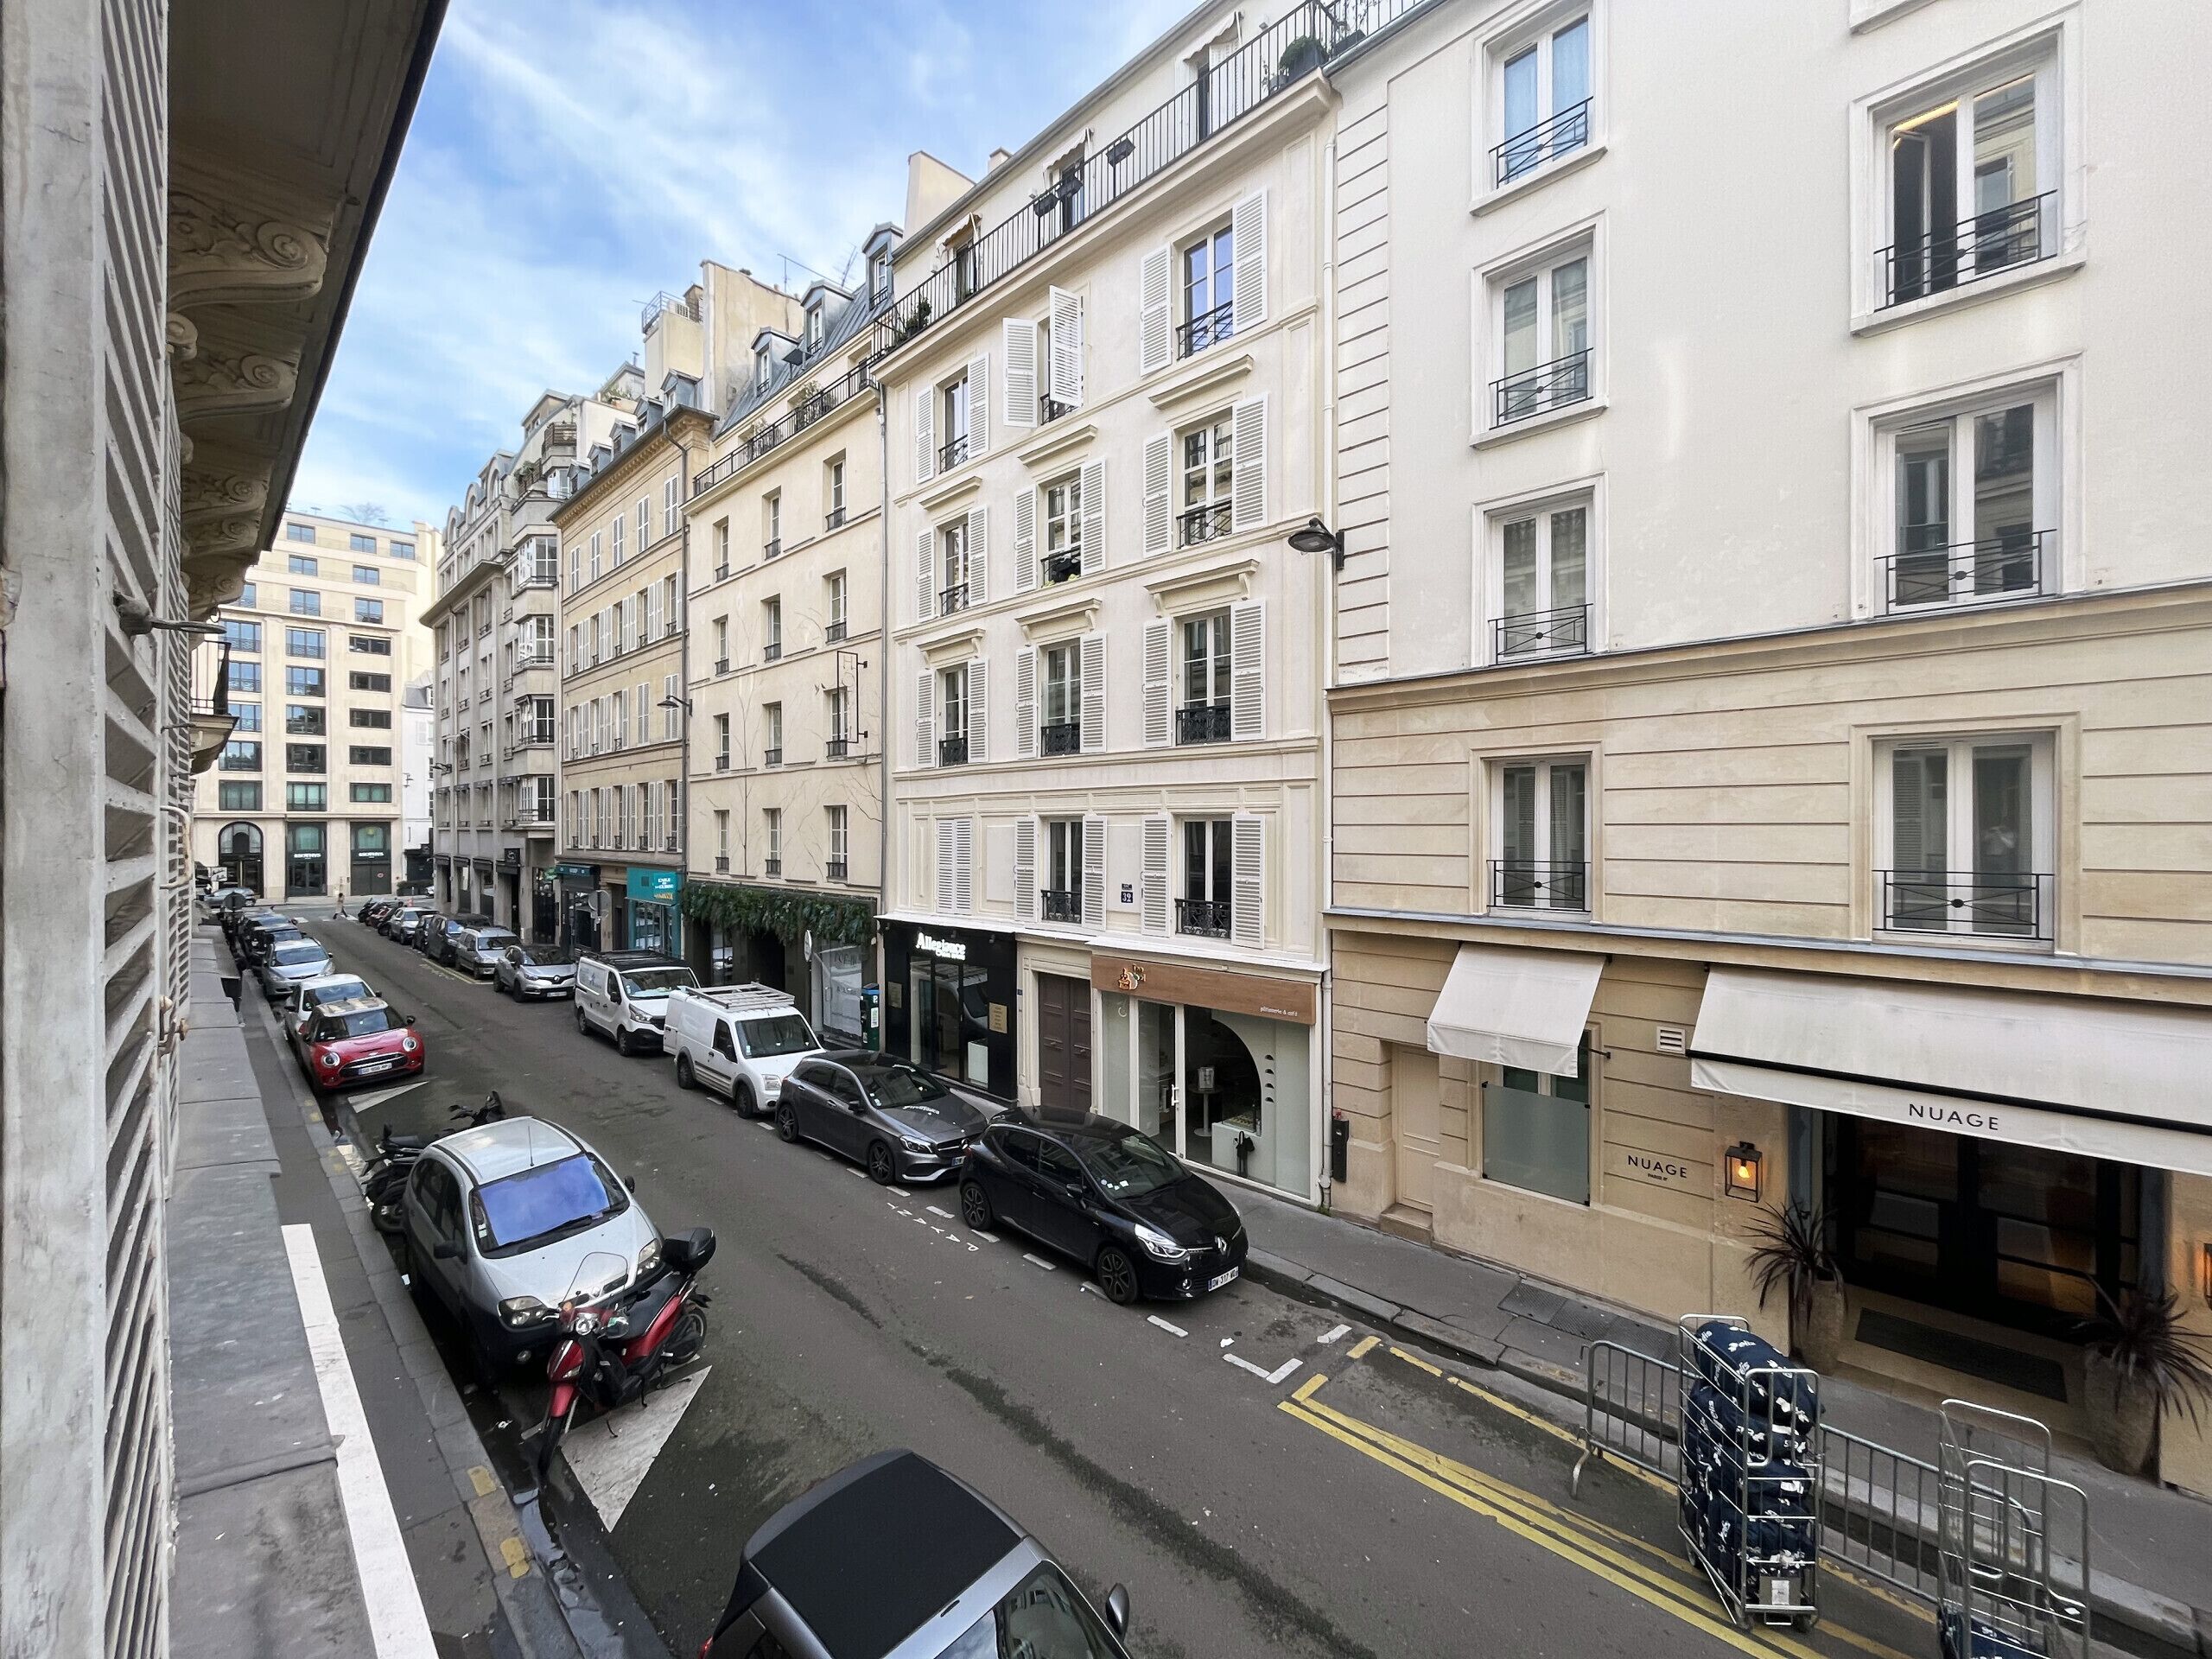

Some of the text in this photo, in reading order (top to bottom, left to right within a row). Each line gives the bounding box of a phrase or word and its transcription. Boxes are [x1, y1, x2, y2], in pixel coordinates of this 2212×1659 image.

[1122, 893, 1132, 902] 32
[1909, 1103, 1999, 1131] NUAGE
[1628, 1154, 1688, 1179] NUAGE
[887, 1202, 980, 1252] PAYANT
